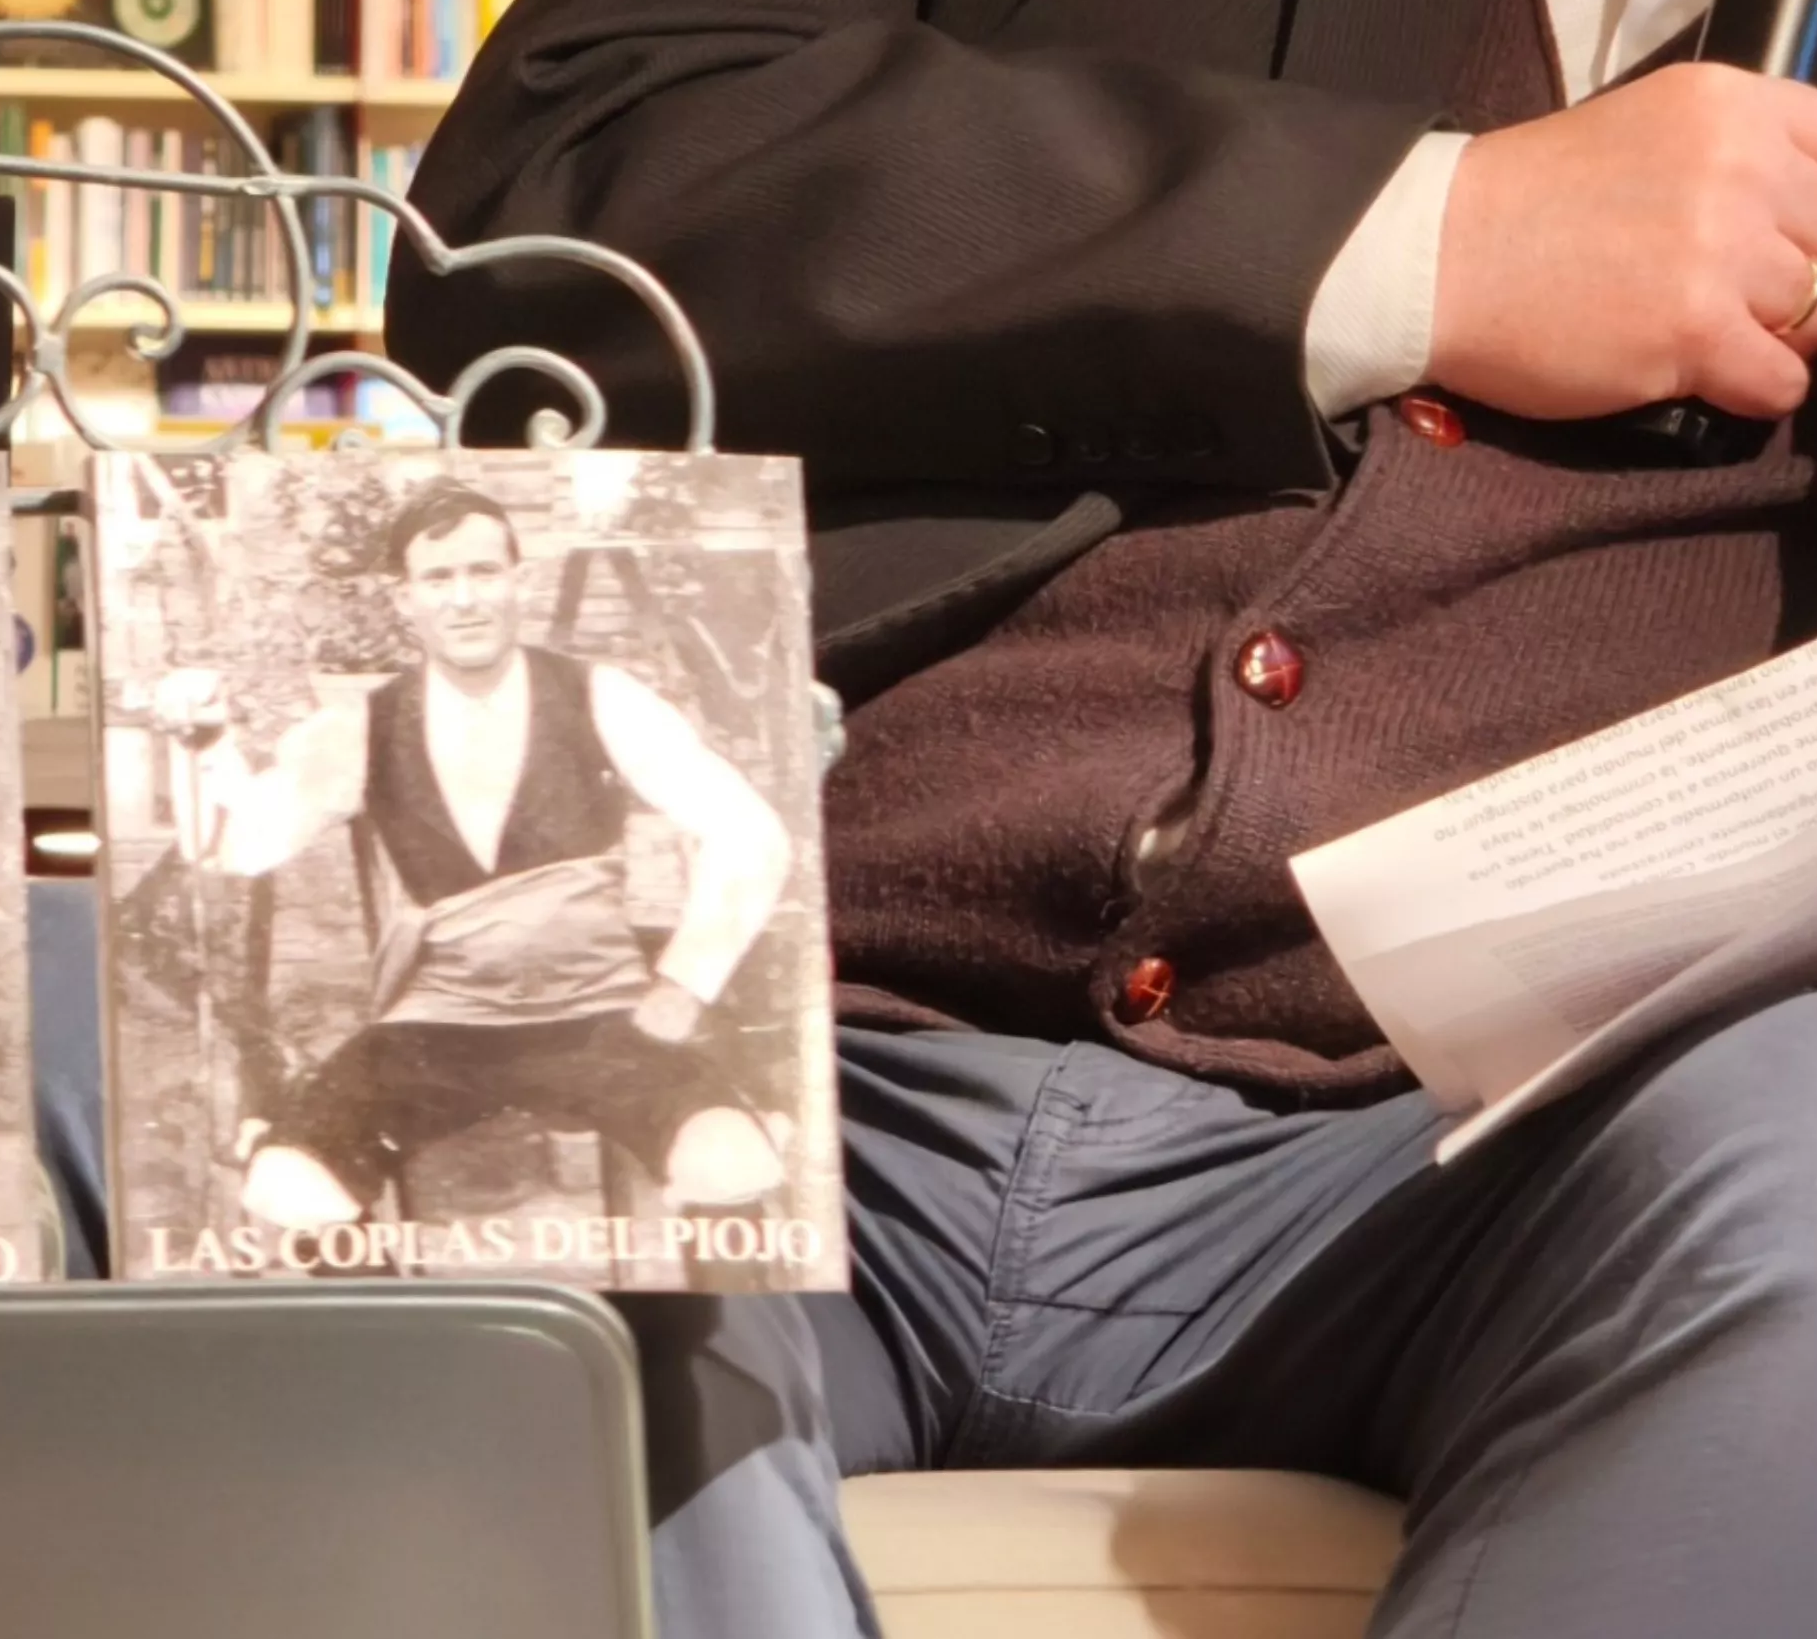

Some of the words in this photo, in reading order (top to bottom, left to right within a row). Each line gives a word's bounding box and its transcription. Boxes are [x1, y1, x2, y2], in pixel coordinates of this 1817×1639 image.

[146, 1225, 266, 1272] LAS
[278, 1217, 516, 1270] COPLAS
[532, 1216, 640, 1262] DEL
[659, 1216, 822, 1263] PIOJO
